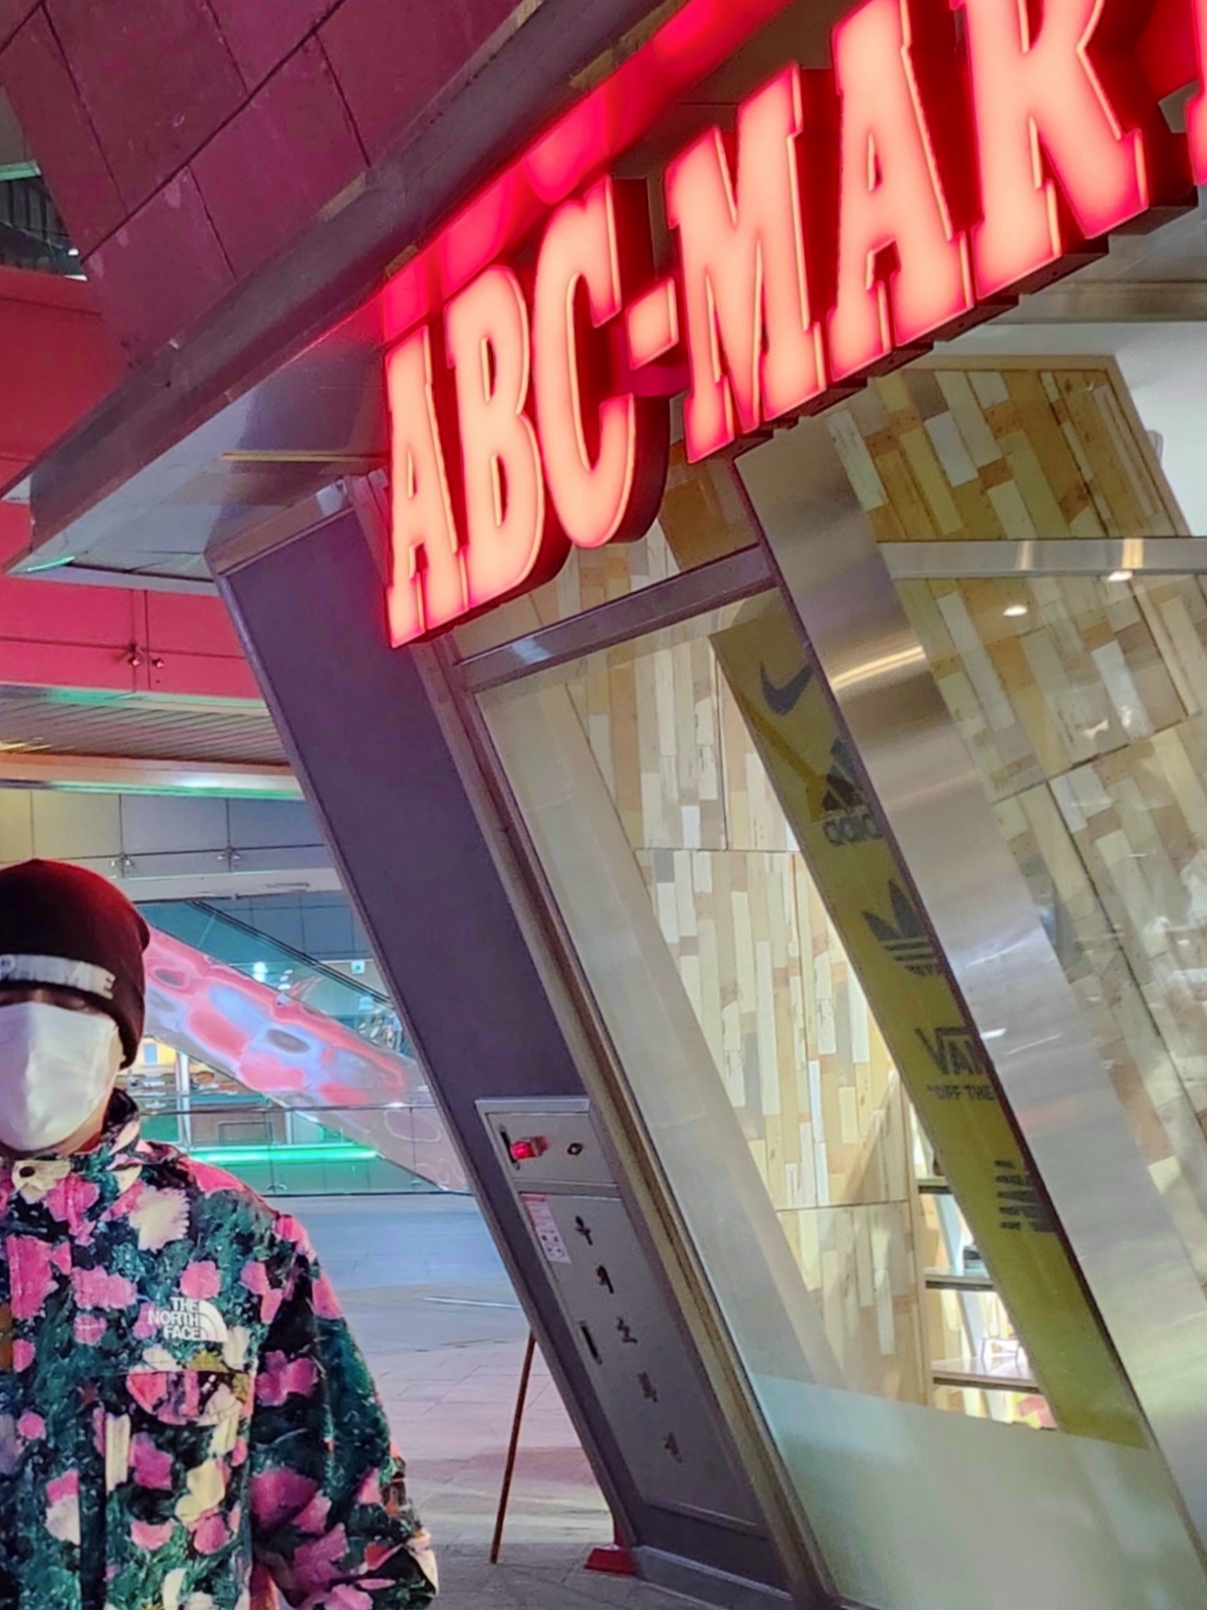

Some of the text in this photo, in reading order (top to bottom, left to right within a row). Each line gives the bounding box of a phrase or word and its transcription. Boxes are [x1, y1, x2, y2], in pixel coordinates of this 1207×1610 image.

[384, 0, 1207, 650] ABC-MAR
[914, 1027, 986, 1076] VAN
[170, 1296, 199, 1312] THE
[147, 1310, 200, 1327] NORTH
[164, 1325, 201, 1341] FACE
